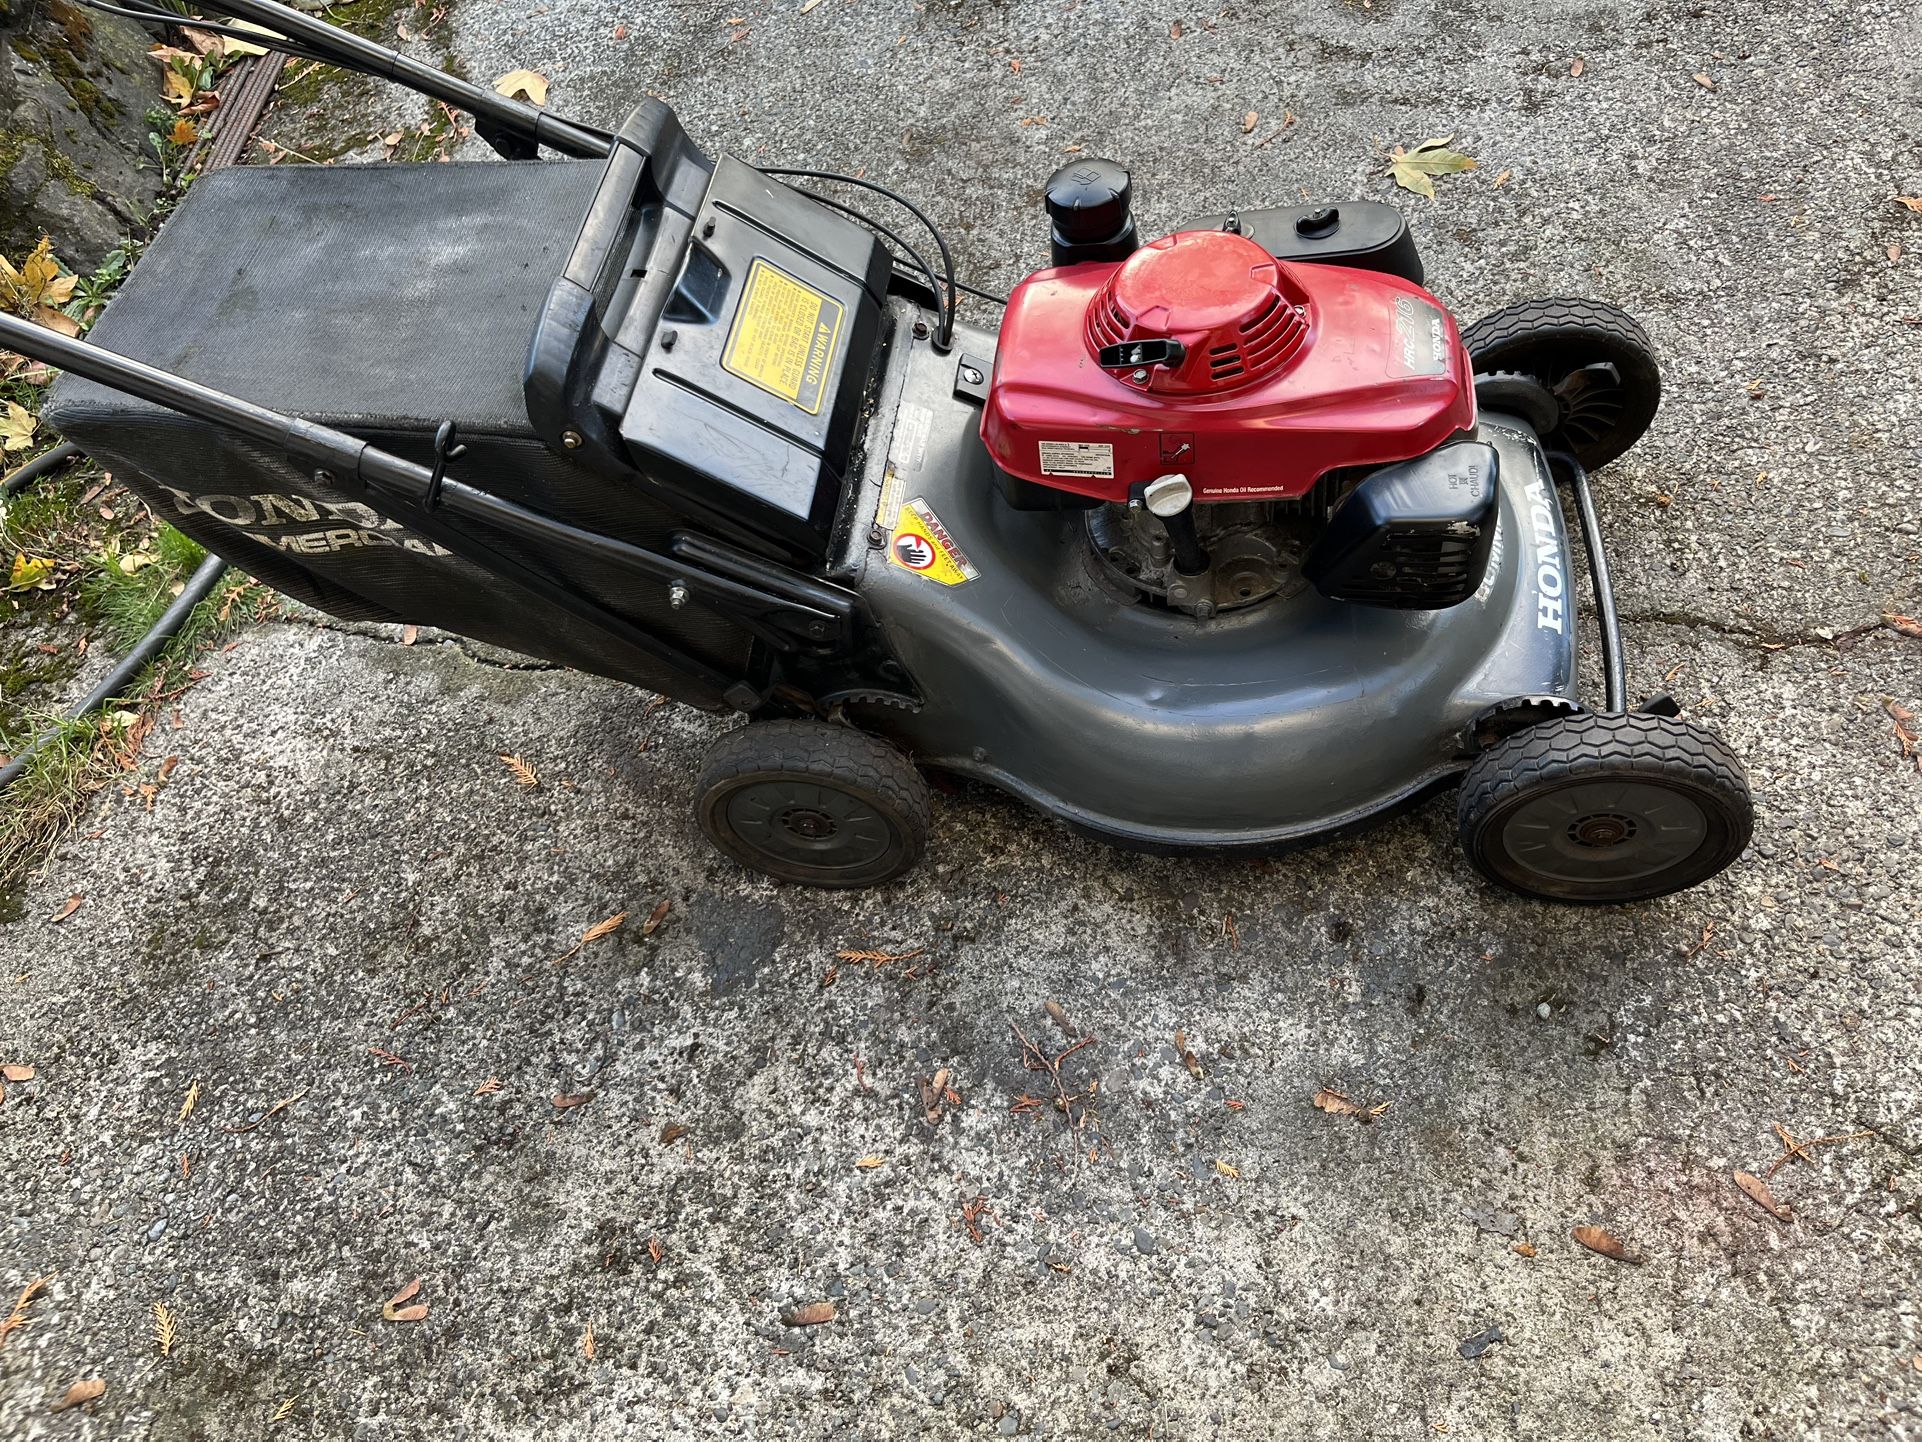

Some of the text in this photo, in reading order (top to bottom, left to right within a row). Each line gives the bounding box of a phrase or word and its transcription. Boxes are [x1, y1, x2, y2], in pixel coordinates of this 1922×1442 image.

[795, 303, 807, 326] CLOSED
[805, 310, 814, 324] NOT
[789, 335, 798, 349] BAG
[800, 324, 811, 343] START
[1432, 319, 1441, 361] HONDA
[794, 343, 806, 367] UNLESS
[805, 334, 829, 385] WARNING
[787, 367, 800, 390] GUARD
[1449, 474, 1457, 489] HOT
[917, 519, 933, 540] HANDS
[920, 511, 968, 567] DANGER
[1525, 479, 1562, 635] HONDA
